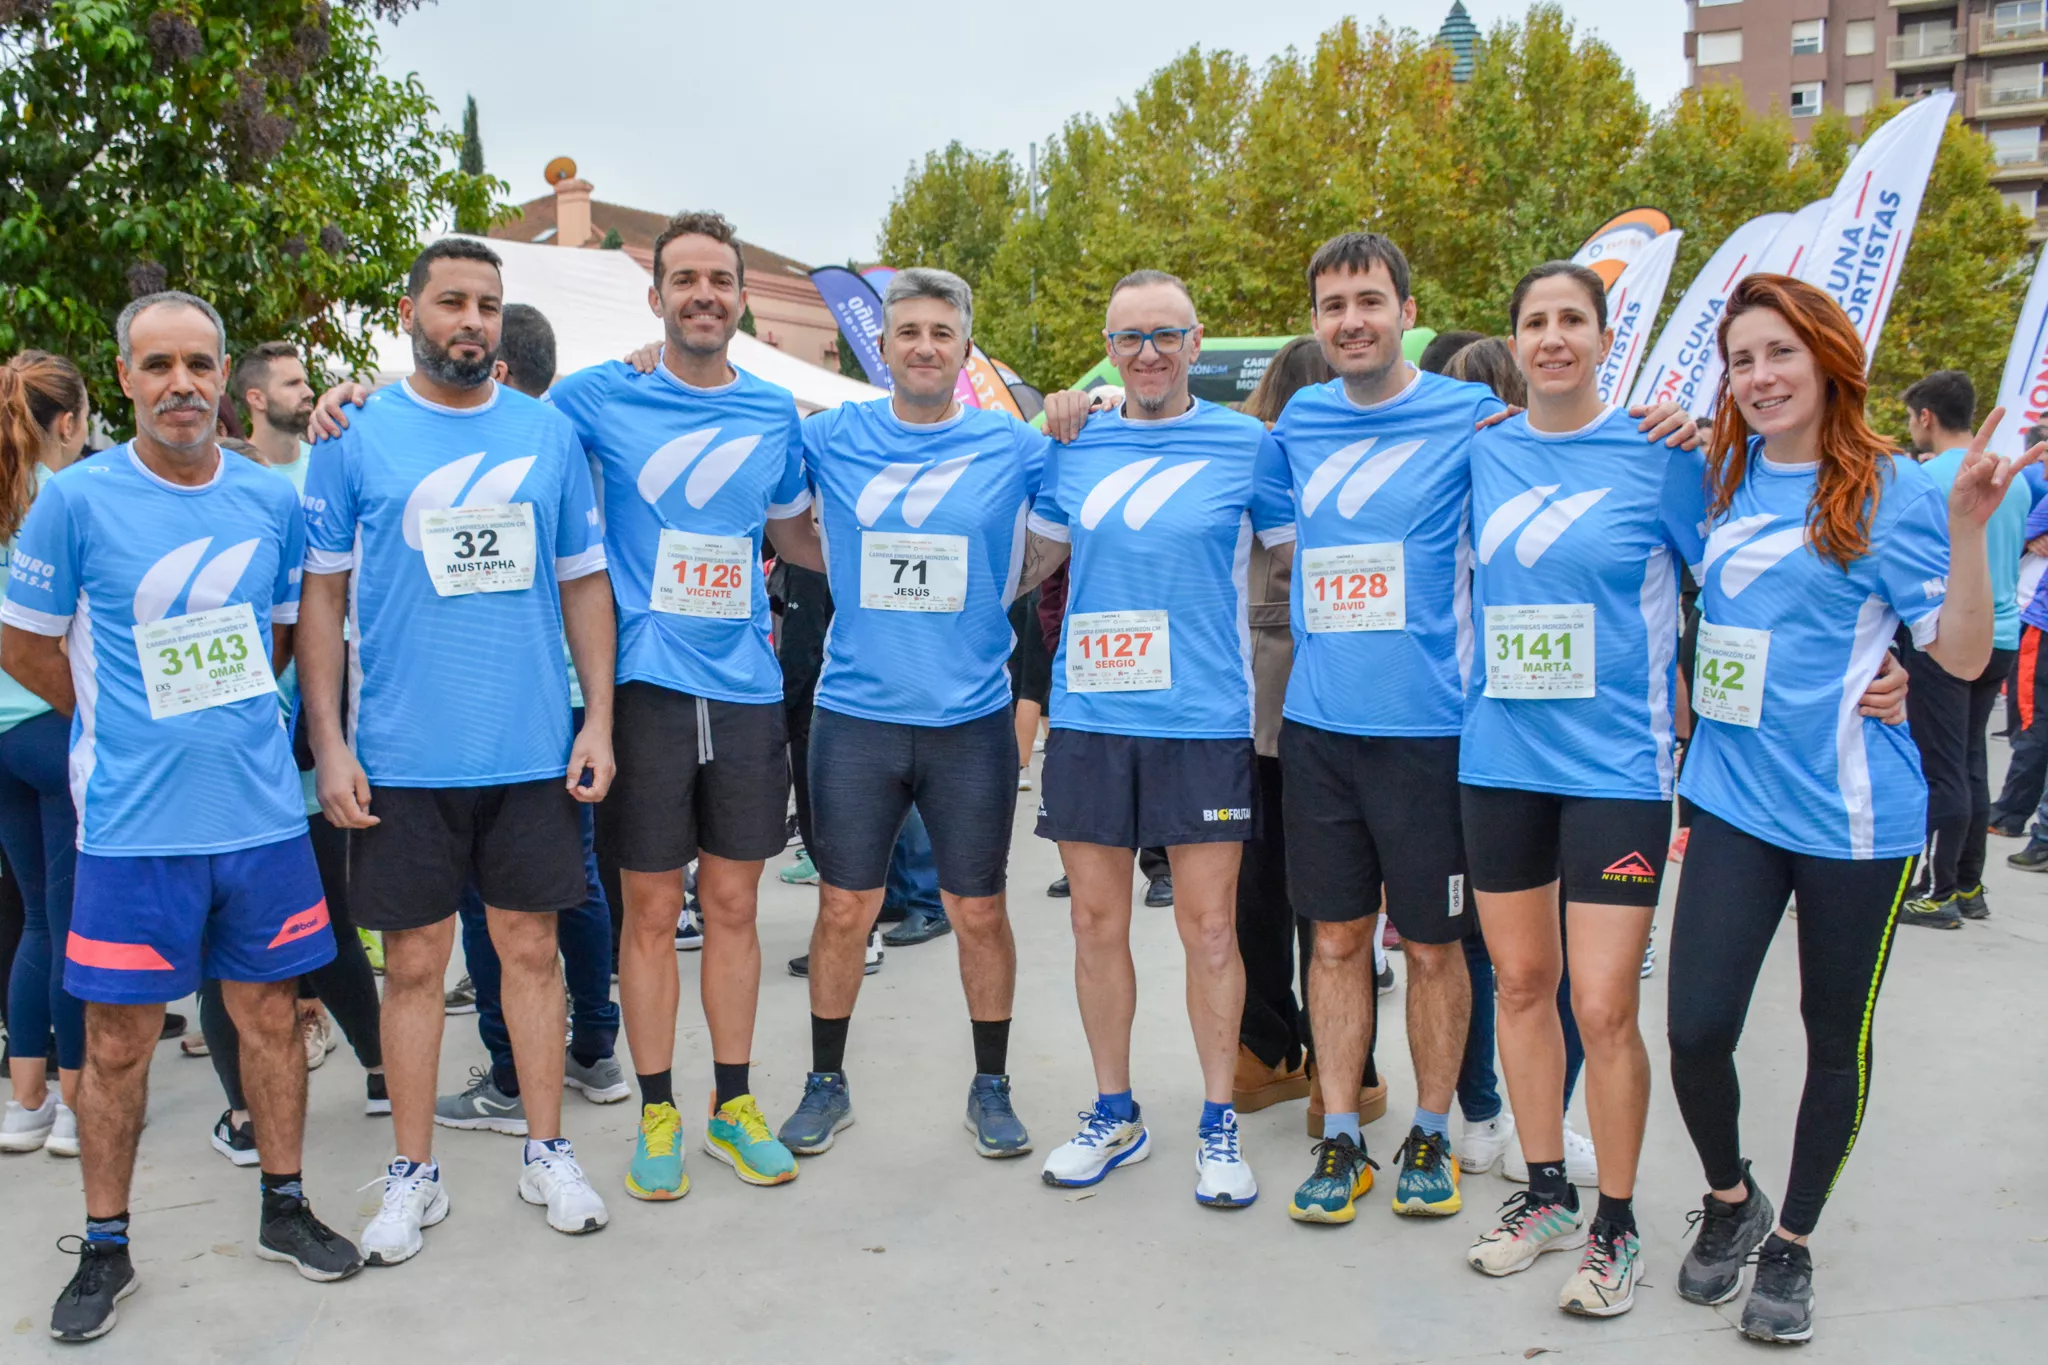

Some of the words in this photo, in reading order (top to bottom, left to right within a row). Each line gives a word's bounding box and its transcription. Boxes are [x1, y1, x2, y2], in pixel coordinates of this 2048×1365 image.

[1826, 226, 1864, 308] UNA
[1678, 298, 1725, 367] CUNA
[452, 529, 500, 559] 32
[446, 560, 516, 574] MUSTAPHA
[673, 560, 742, 588] 1126
[890, 559, 927, 585] 71
[686, 587, 732, 599] VICENTE
[894, 586, 930, 597] JESÚS
[1314, 572, 1388, 602] 1128
[1333, 601, 1366, 611] DAVID
[159, 634, 248, 676] 3143
[1079, 632, 1153, 660] 1127
[1496, 632, 1571, 660] 3141
[208, 662, 246, 679] OMAR
[1095, 659, 1136, 669] SERGIO
[1523, 662, 1572, 672] MARTA
[1703, 686, 1727, 701] EVA
[1602, 873, 1628, 882] NIKE
[1452, 880, 1460, 908] adidas
